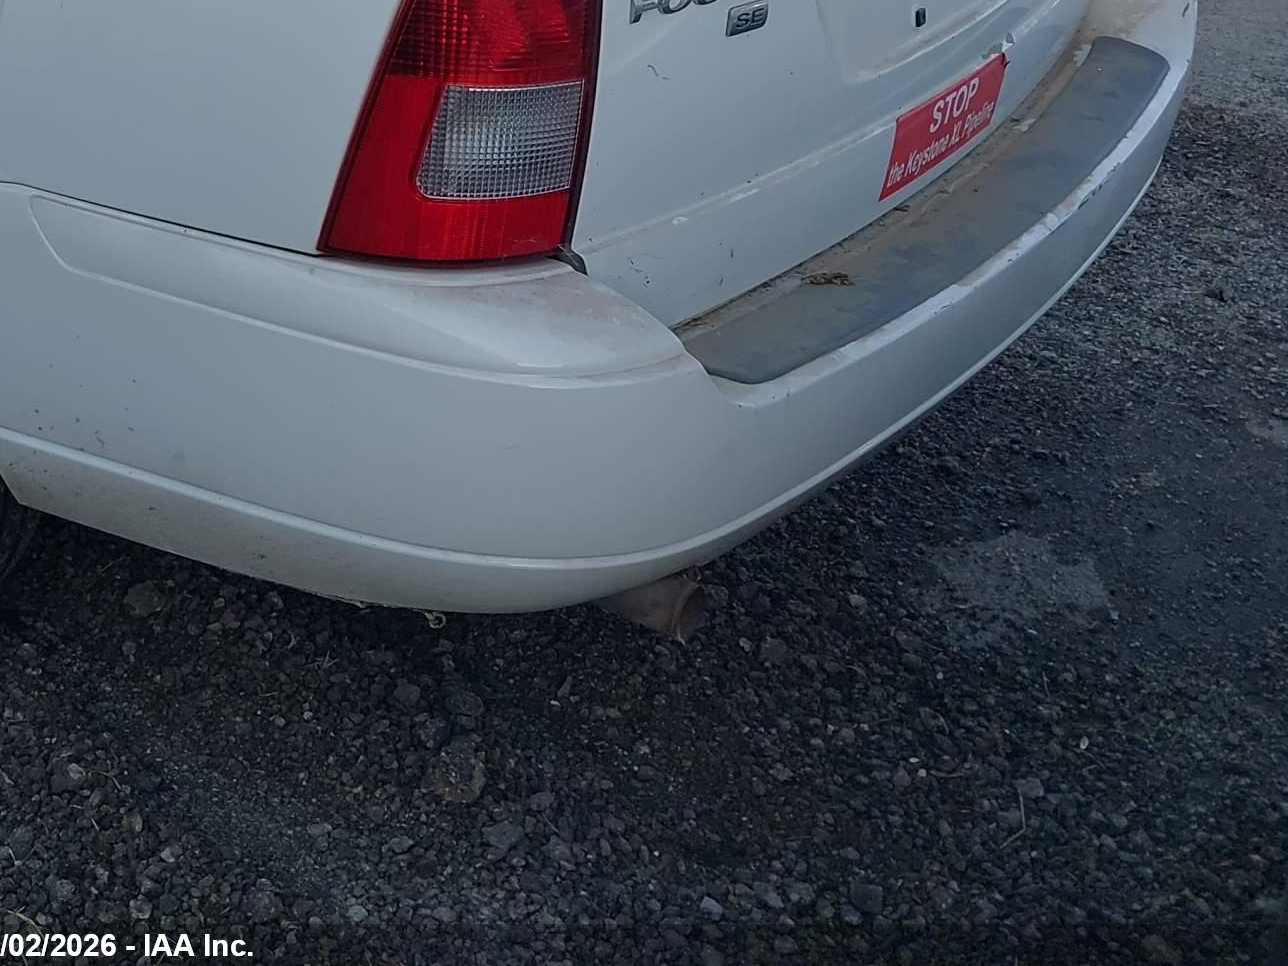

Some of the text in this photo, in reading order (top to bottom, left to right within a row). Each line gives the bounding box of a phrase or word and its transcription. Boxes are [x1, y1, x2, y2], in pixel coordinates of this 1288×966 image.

[735, 7, 765, 29] SE
[929, 77, 980, 133] STOP
[887, 162, 905, 188] the
[904, 135, 950, 177] Keystone
[948, 125, 962, 148] XL
